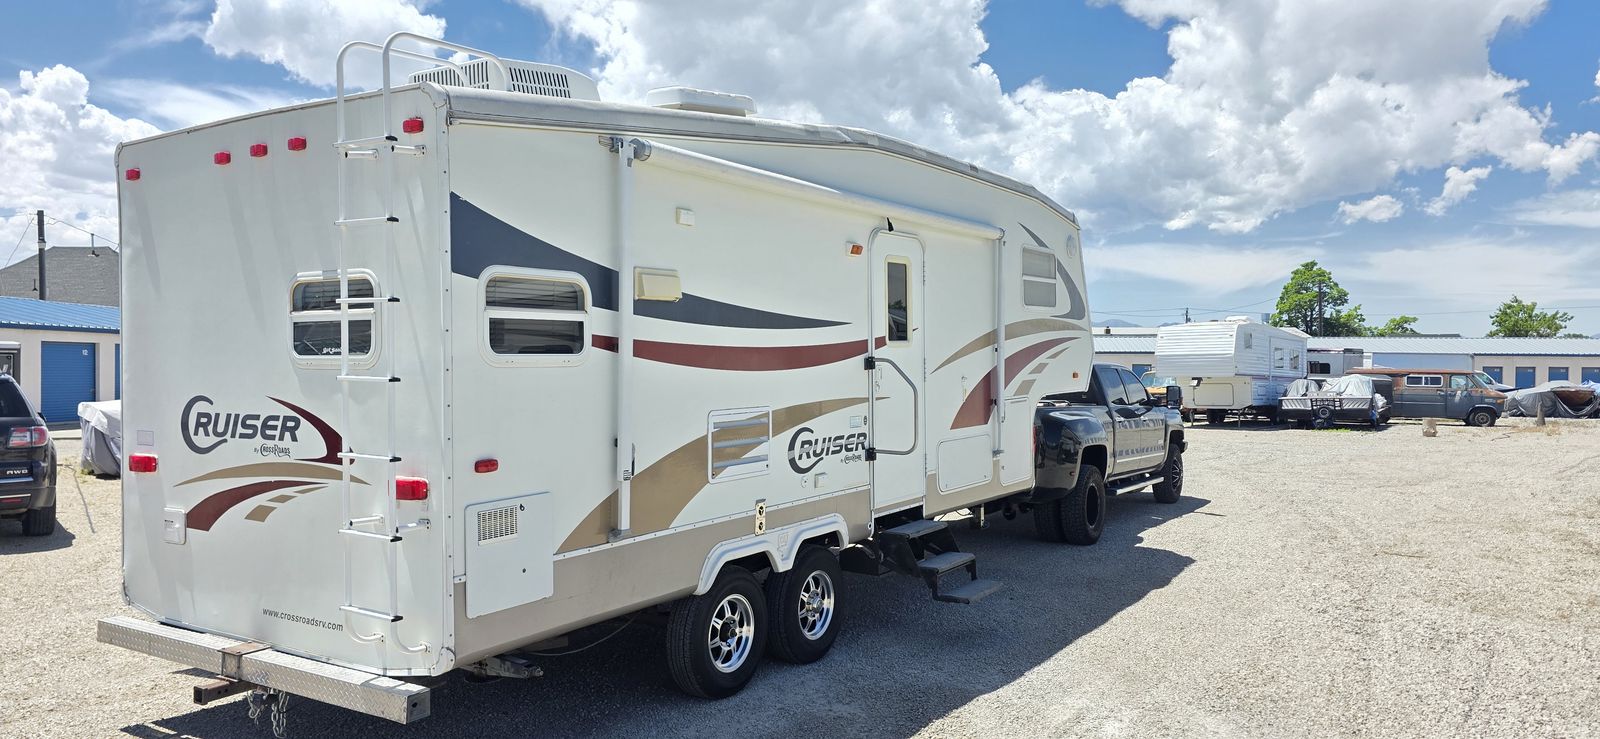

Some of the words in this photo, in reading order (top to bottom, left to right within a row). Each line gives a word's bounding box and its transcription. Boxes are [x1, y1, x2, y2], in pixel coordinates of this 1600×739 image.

[180, 394, 302, 455] CRUISER
[787, 426, 869, 475] CRUISER
[262, 608, 344, 631] www.crossroadsrv.com
